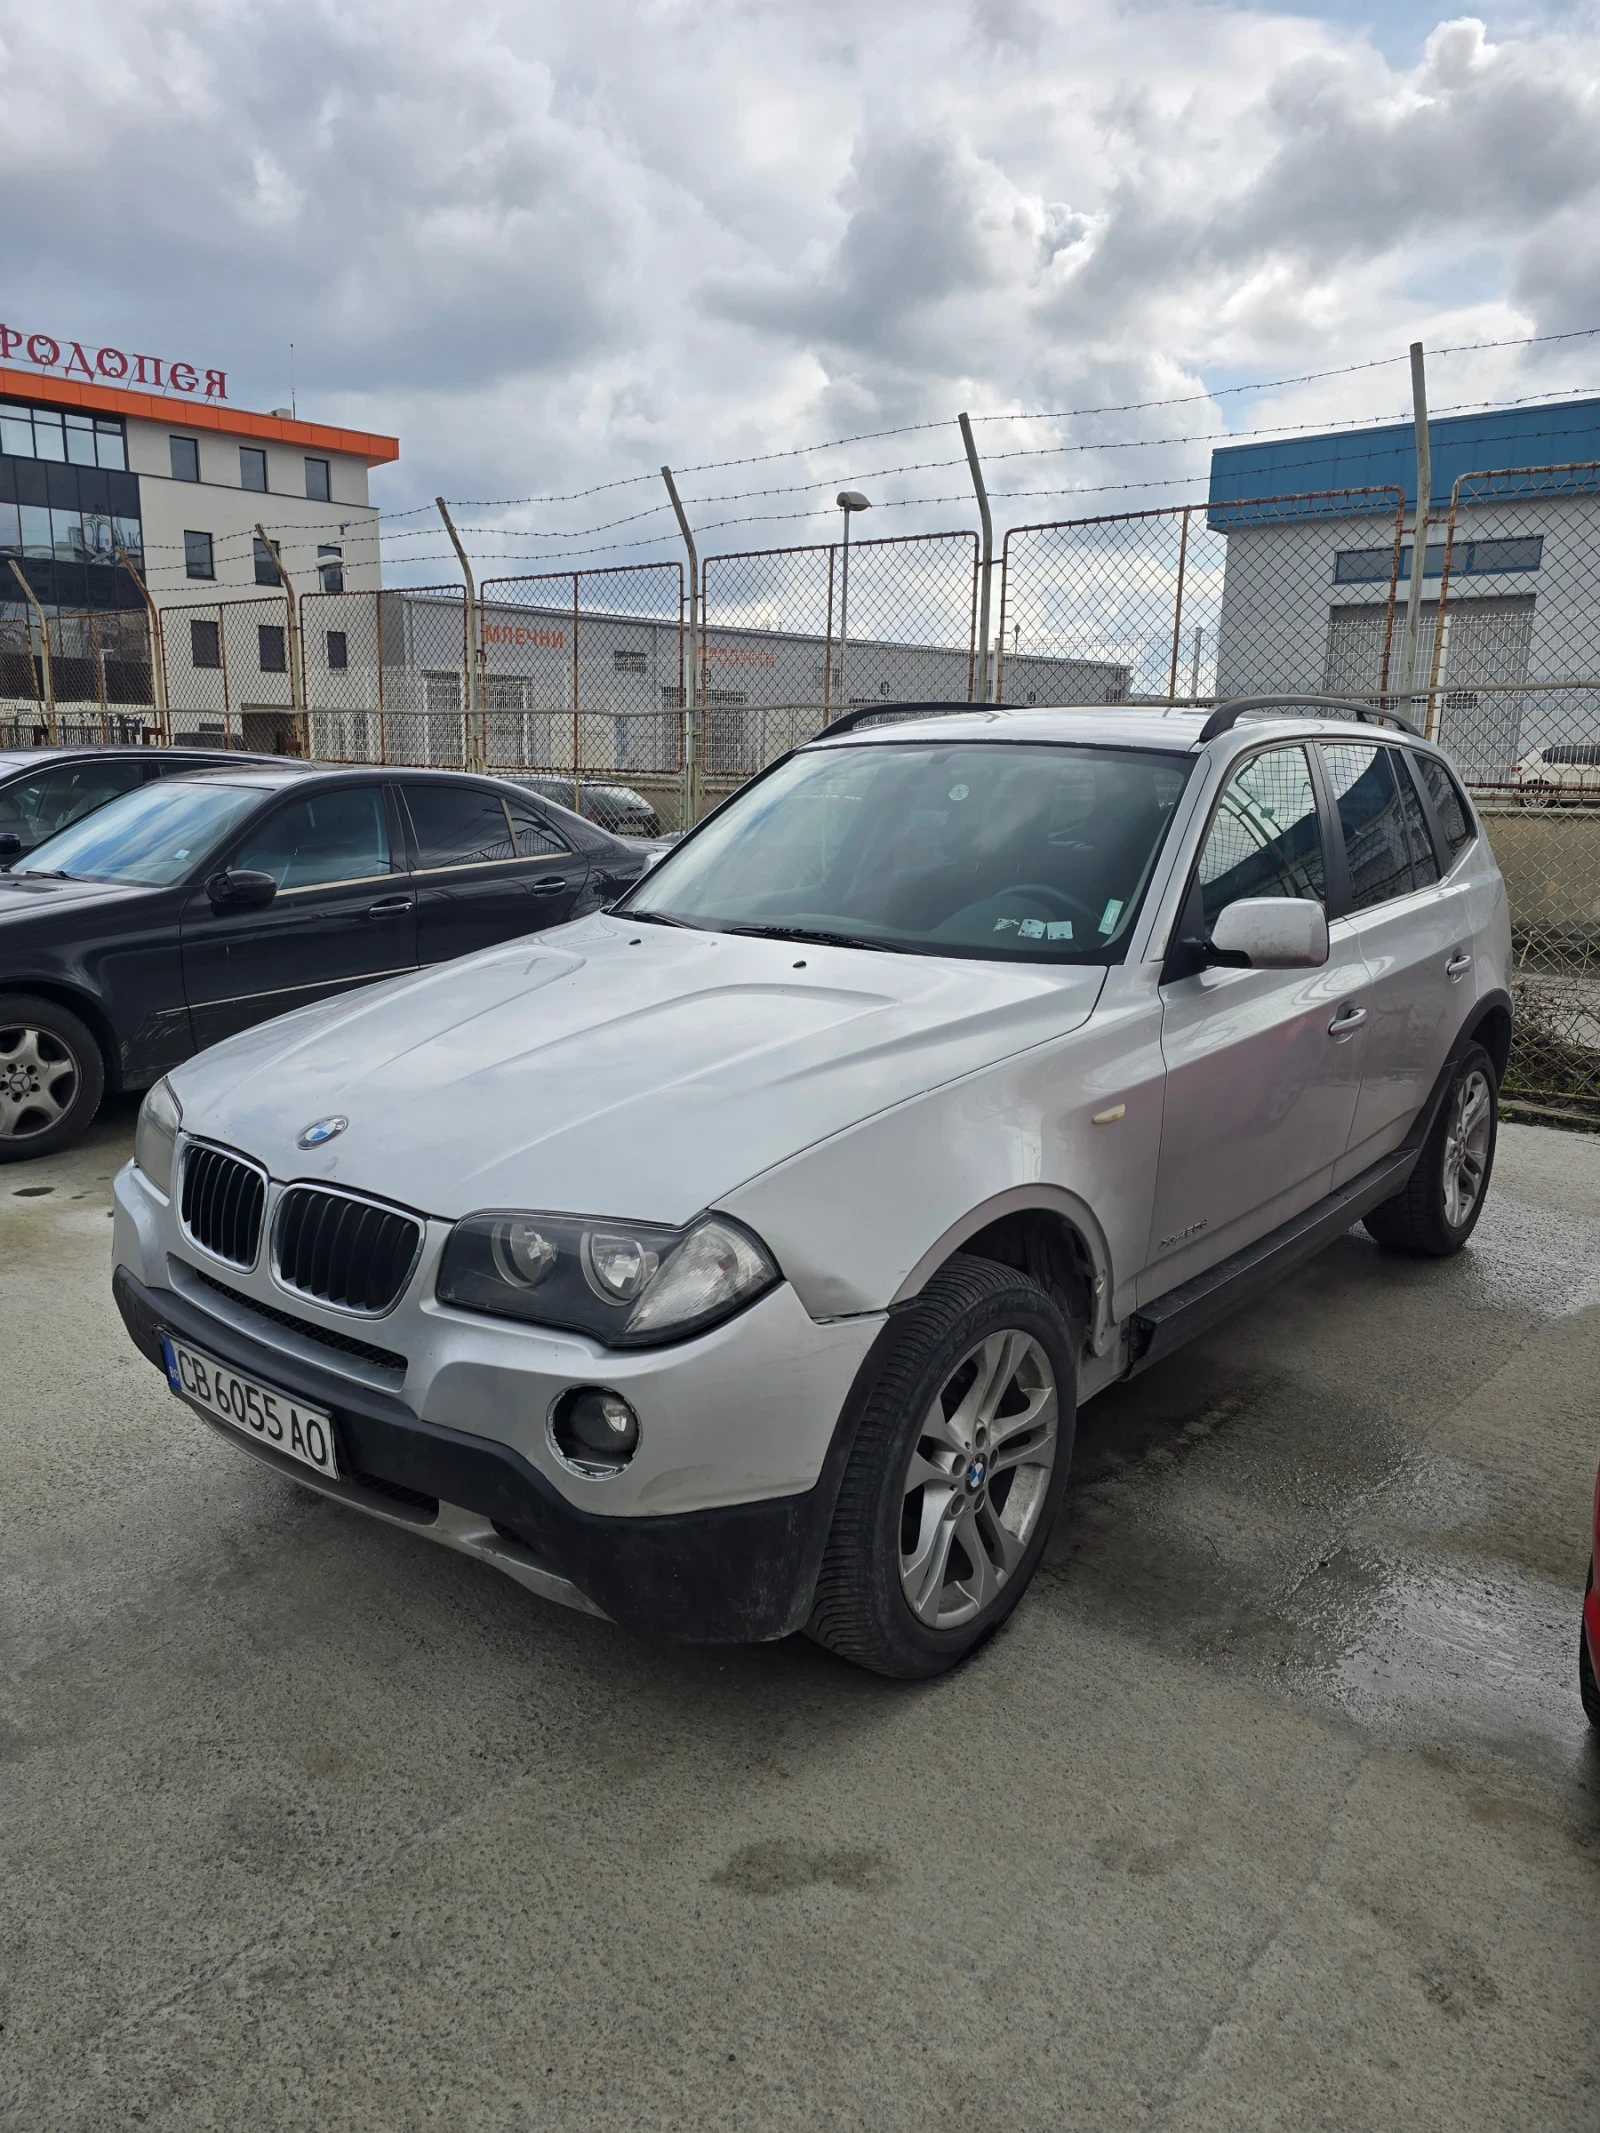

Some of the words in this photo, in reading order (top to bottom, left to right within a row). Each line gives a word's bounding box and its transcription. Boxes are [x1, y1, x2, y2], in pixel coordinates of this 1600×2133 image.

[0, 323, 229, 399] РОДОПЕЯ
[485, 624, 565, 648] МЛЕЧНИ
[168, 1366, 180, 1381] BG
[178, 1348, 212, 1403] CB
[215, 1371, 283, 1441] 6055
[291, 1409, 327, 1466] AO
